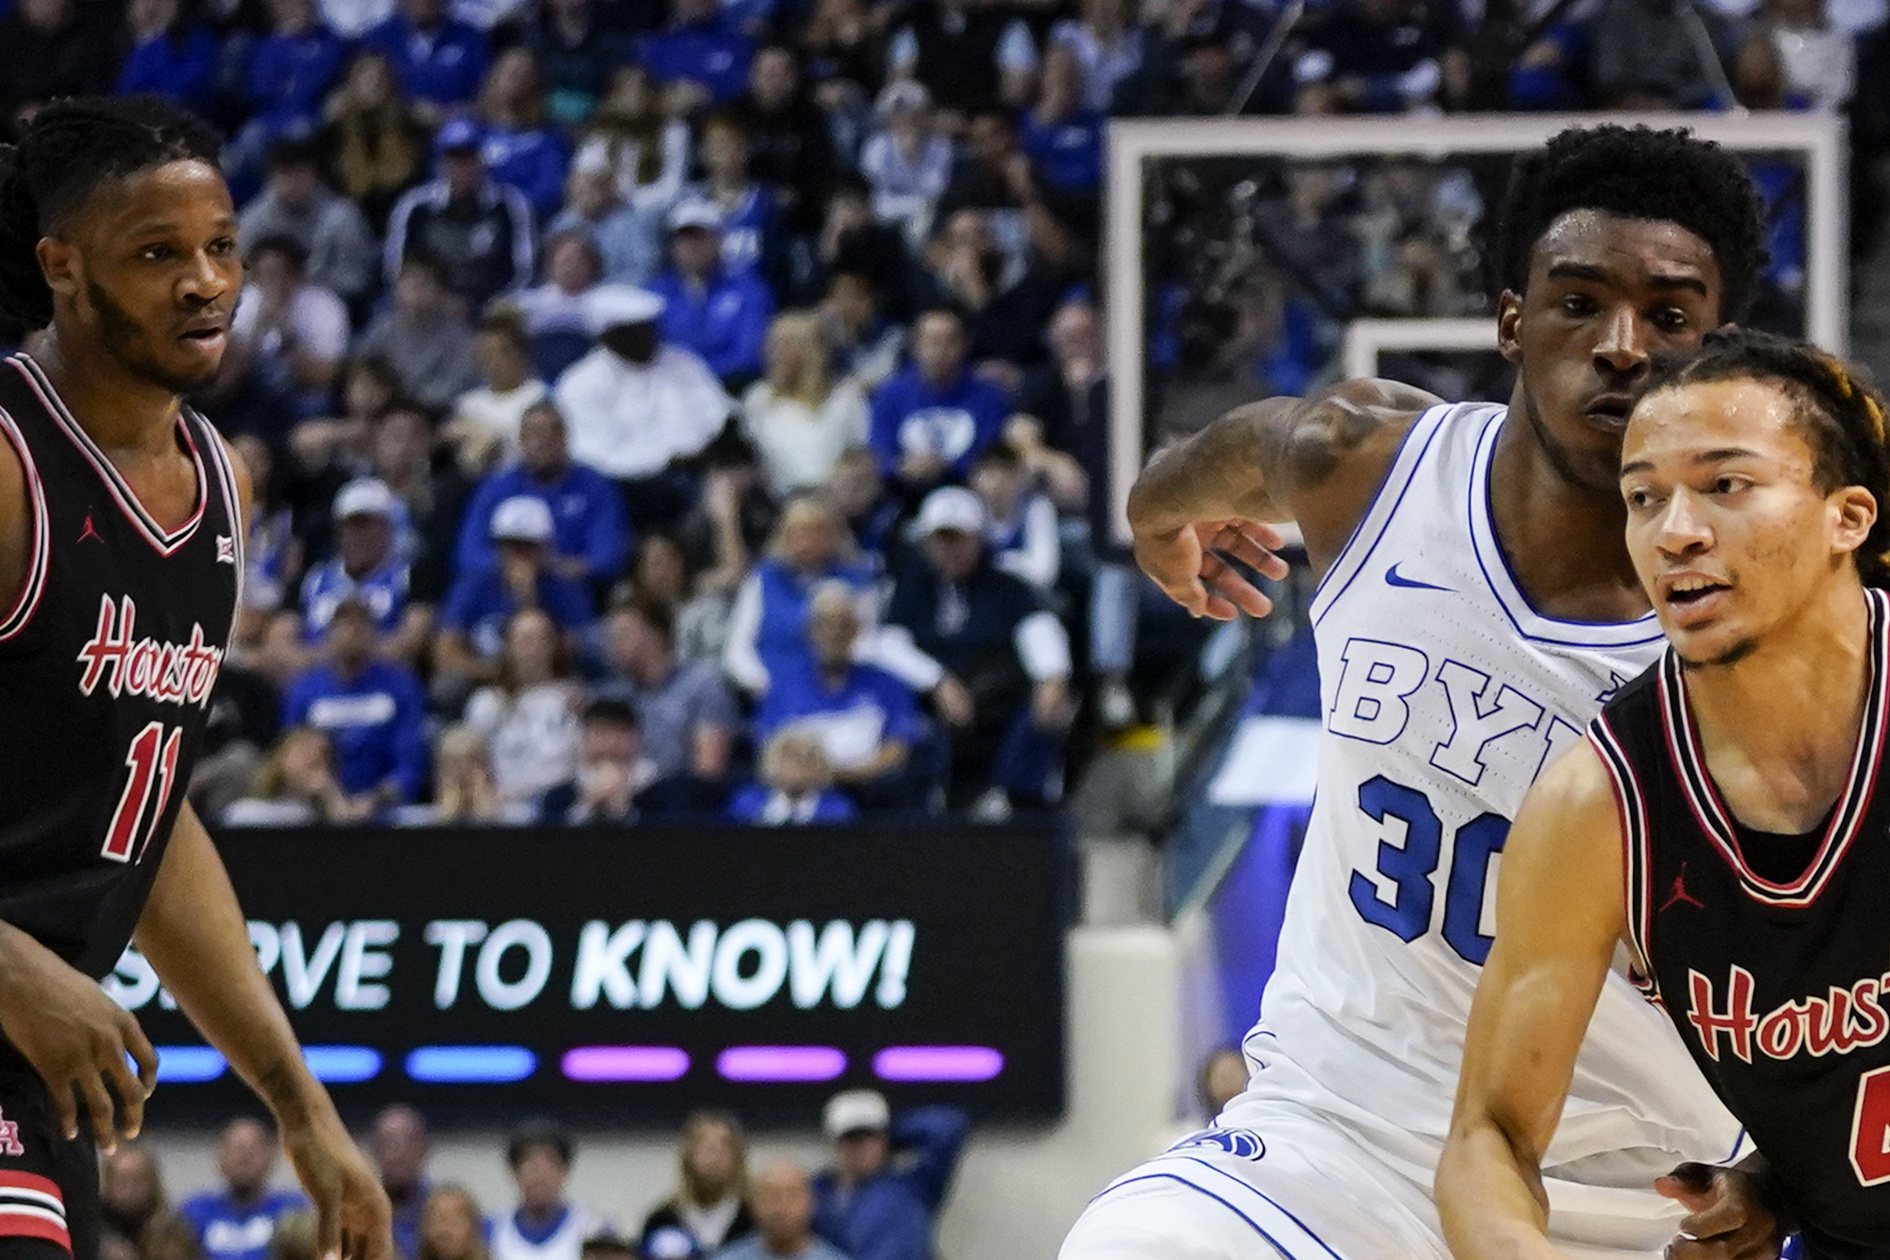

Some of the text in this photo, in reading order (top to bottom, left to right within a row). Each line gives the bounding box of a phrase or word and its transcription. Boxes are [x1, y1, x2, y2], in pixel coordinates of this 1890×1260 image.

[1328, 637, 1584, 788] BY
[101, 720, 183, 866] 11
[424, 918, 553, 1012] TO
[569, 918, 916, 1012] KNOW!
